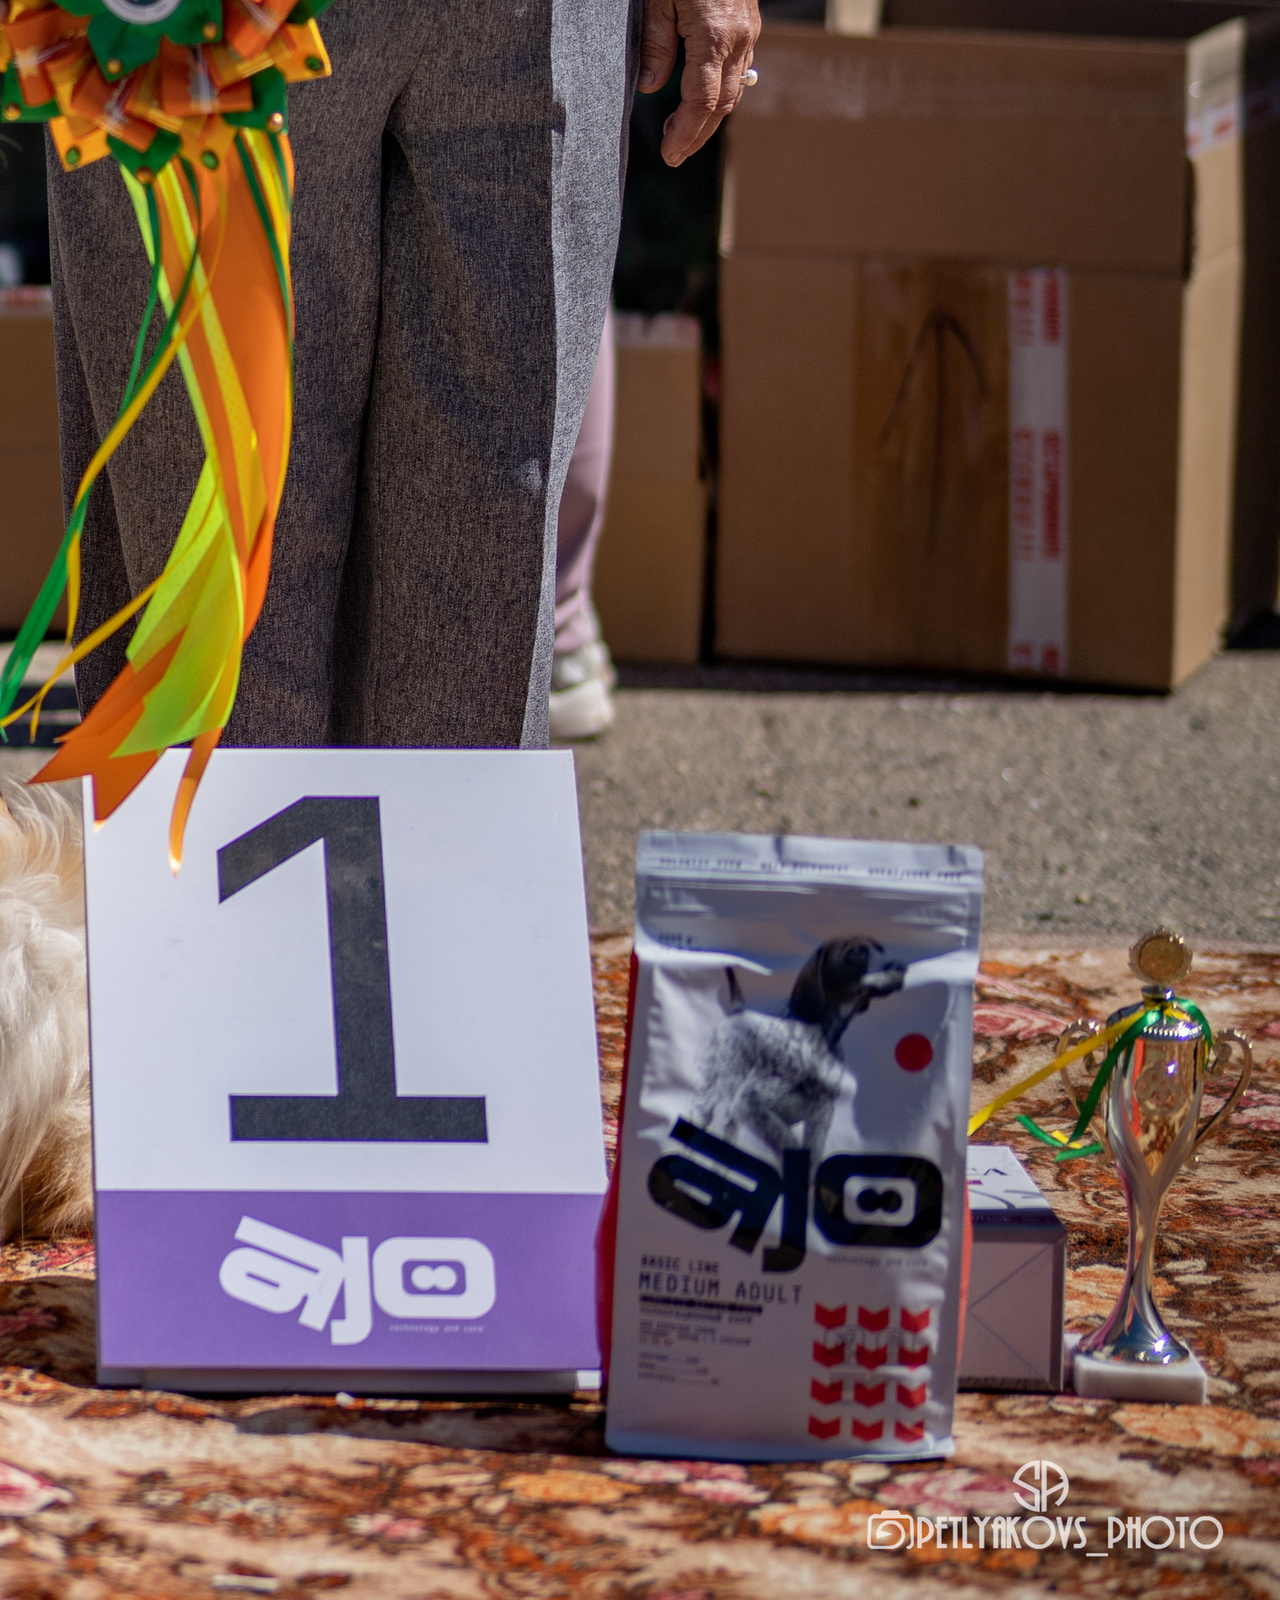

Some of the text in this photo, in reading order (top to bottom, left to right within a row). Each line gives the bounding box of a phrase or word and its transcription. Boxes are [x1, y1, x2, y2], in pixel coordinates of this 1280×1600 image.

[217, 795, 488, 1144] 1
[641, 1255, 720, 1273] BASIC LINE
[639, 1272, 720, 1296] MEDIUM
[735, 1281, 802, 1304] ADULT
